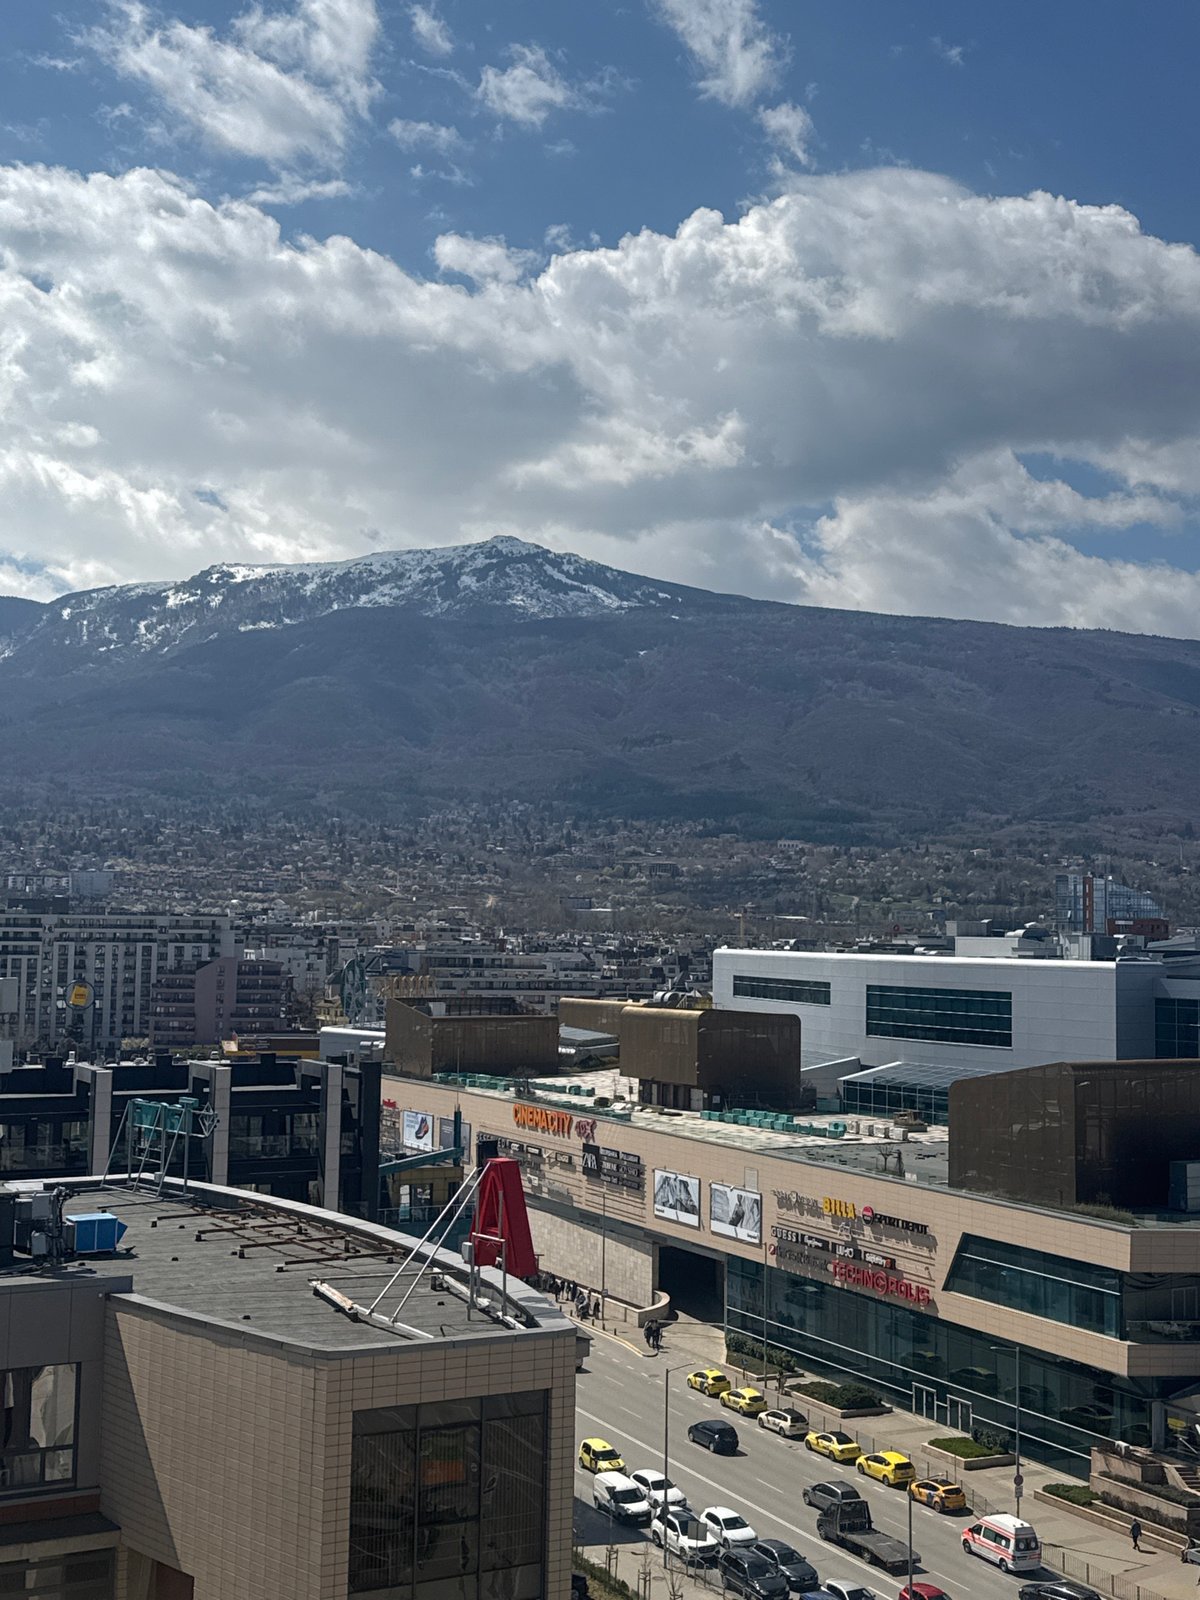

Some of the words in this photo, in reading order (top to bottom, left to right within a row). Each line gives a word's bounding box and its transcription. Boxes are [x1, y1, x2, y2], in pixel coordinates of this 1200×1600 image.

[582, 1152, 598, 1170] ZARA
[823, 1196, 857, 1219] BILLA
[771, 1227, 798, 1242] GUESS
[832, 1259, 931, 1307] TECHNOPOLIS
